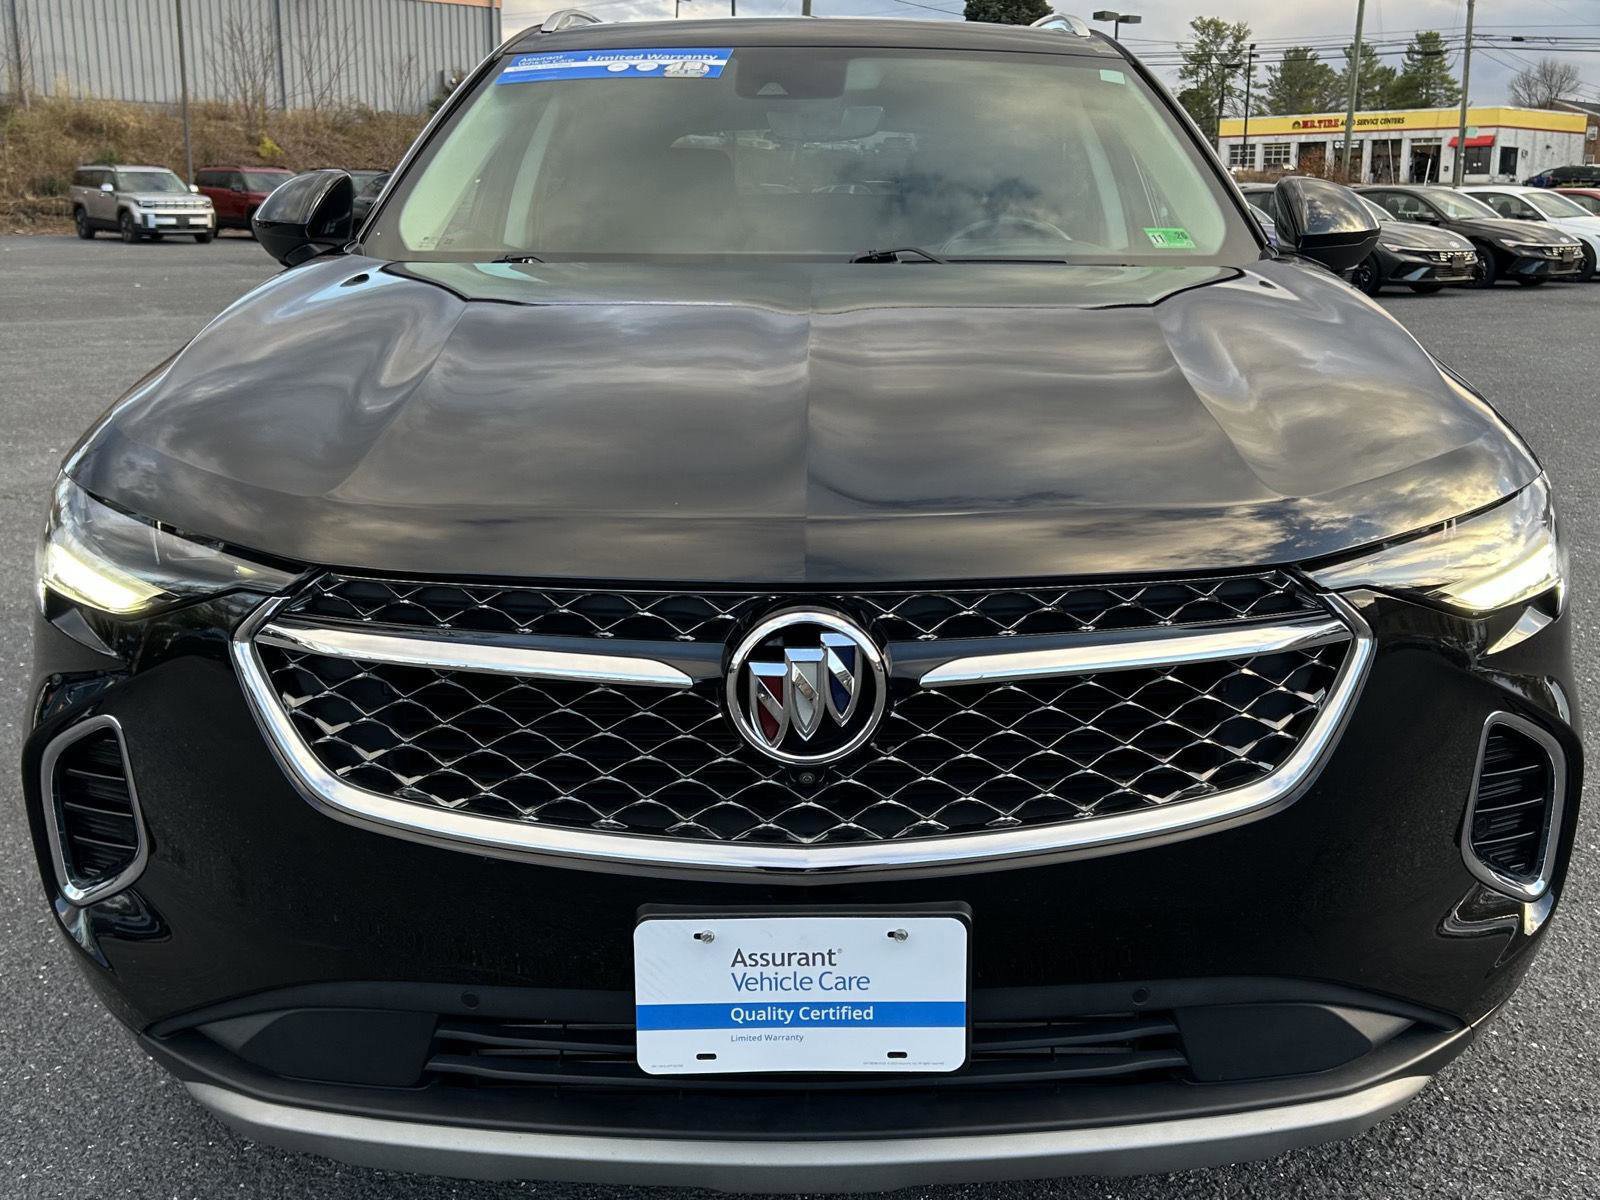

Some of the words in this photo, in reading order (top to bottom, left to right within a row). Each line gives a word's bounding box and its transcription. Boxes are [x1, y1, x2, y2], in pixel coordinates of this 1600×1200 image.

[587, 53, 643, 61] Limited
[646, 53, 718, 61] Warranty
[1379, 117, 1405, 125] CENTERS
[730, 970, 814, 993] Vehicle
[818, 970, 871, 992] Care
[730, 1006, 795, 1025] Quality
[798, 1005, 875, 1021] Certified
[730, 1034, 763, 1042] Limited
[764, 1034, 804, 1042] Warranty
